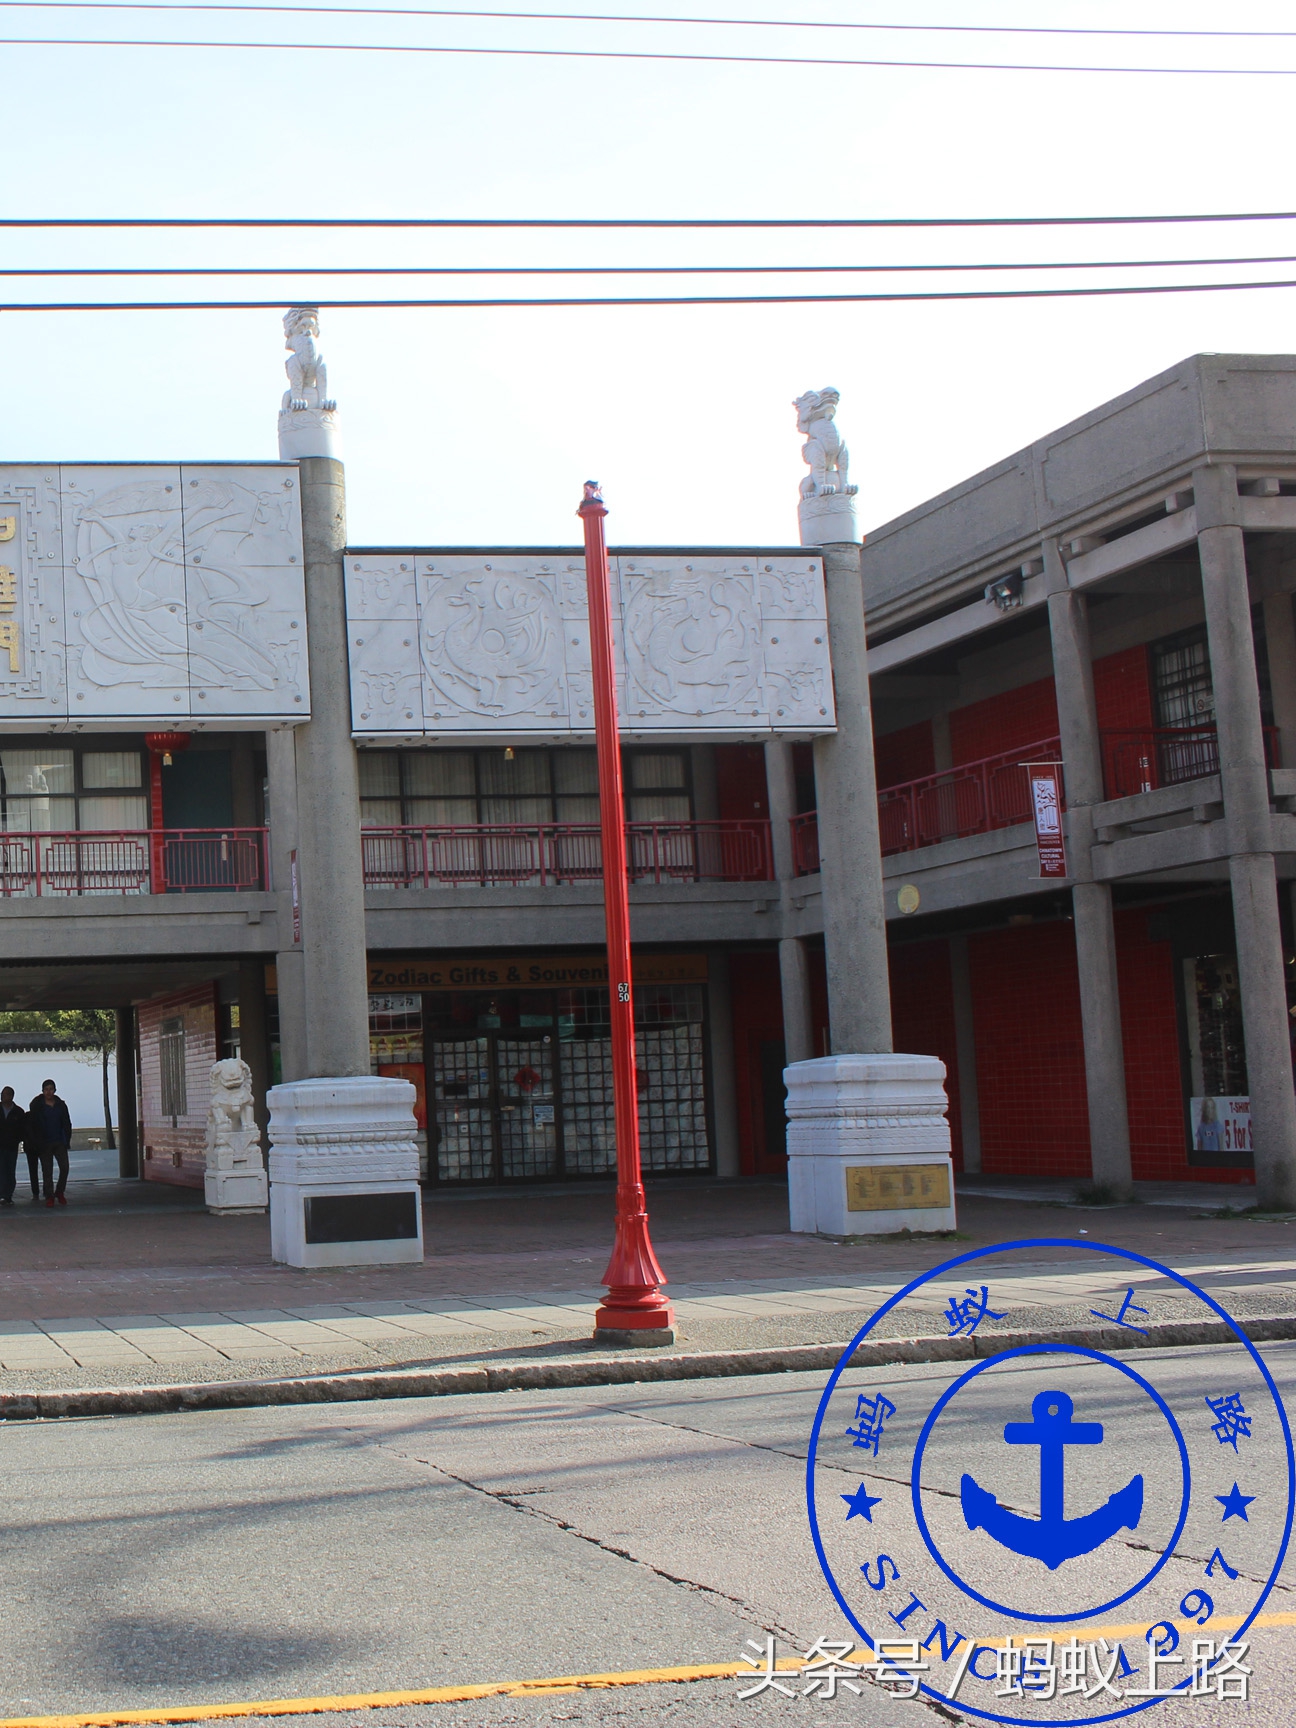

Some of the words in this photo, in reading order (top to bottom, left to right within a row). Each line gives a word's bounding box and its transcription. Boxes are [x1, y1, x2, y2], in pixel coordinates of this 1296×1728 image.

[370, 969, 443, 986] Zodiac
[449, 967, 499, 984] Gifts
[506, 966, 522, 982] &
[528, 964, 608, 981] Souveni
[617, 982, 630, 992] 67
[618, 992, 631, 1002] 50
[1225, 1120, 1230, 1149] 5
[1233, 1119, 1247, 1149] for
